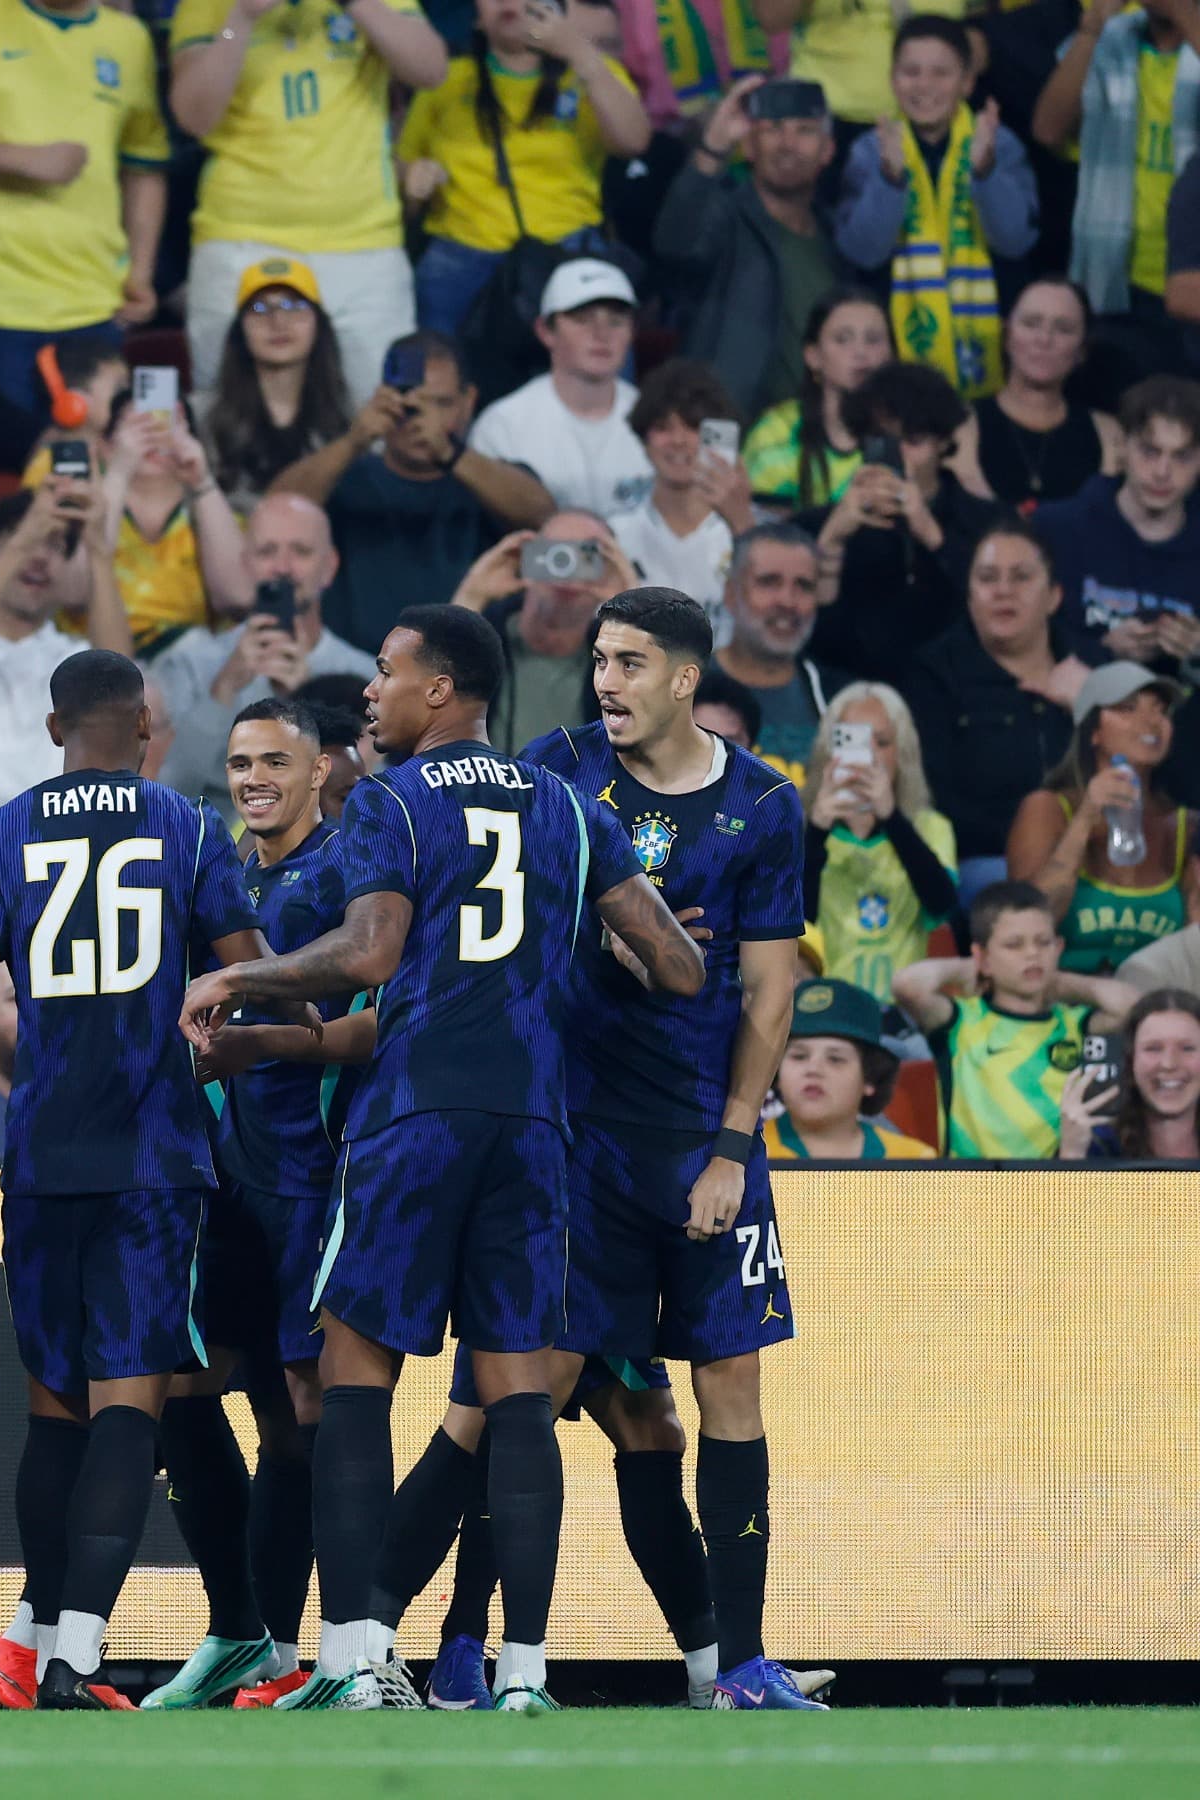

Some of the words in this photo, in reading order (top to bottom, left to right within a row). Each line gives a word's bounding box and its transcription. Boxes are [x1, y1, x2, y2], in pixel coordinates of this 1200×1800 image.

[282, 70, 320, 121] 10
[420, 756, 534, 790] GABRIEL
[42, 784, 137, 819] RAYAN
[644, 840, 660, 849] CBF
[459, 807, 525, 962] 3
[648, 874, 664, 887] SIL
[23, 837, 163, 999] 26
[854, 952, 893, 1002] 10
[735, 1220, 785, 1288] 24
